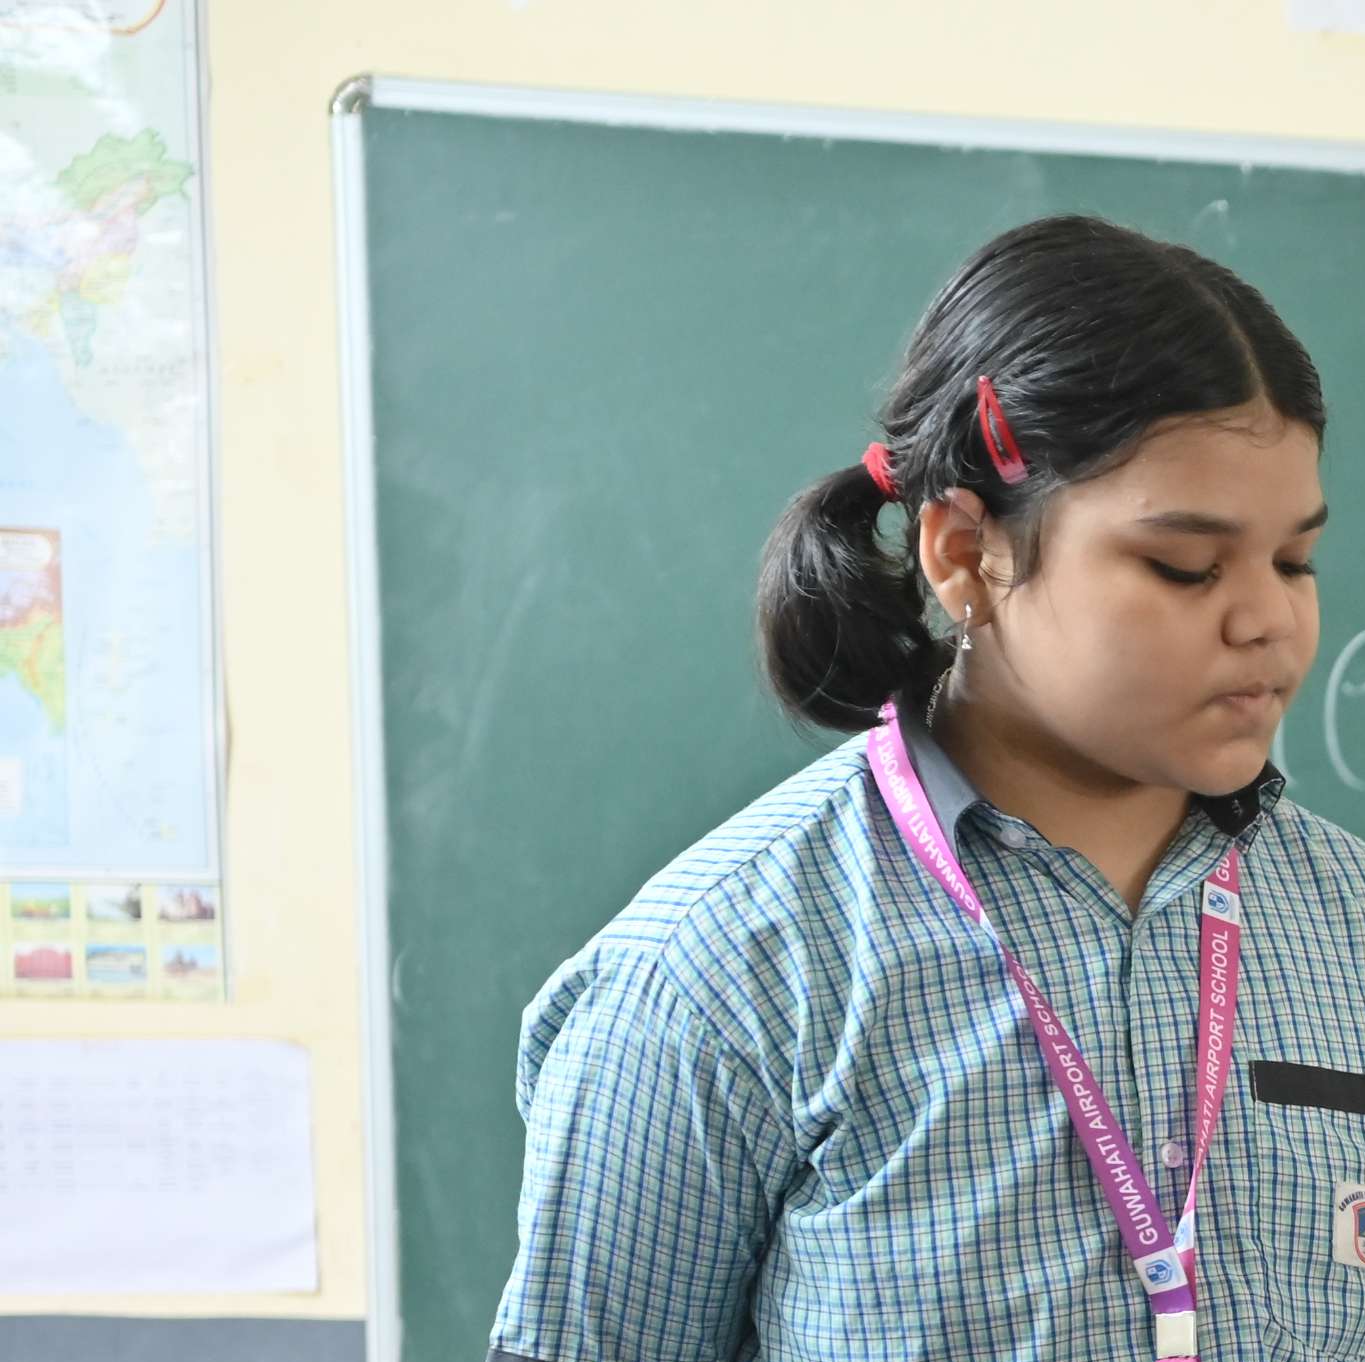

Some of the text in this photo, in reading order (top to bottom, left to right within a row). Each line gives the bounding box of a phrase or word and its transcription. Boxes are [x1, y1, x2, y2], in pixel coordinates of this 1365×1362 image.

[878, 741, 976, 911] GUWAHATI AIRPORT
[1211, 929, 1229, 1007] SCHOOL
[1051, 1041, 1108, 1131] AIRPORT
[1205, 1008, 1226, 1100] AIRPORT
[1095, 1134, 1159, 1246] GUWAHATI
